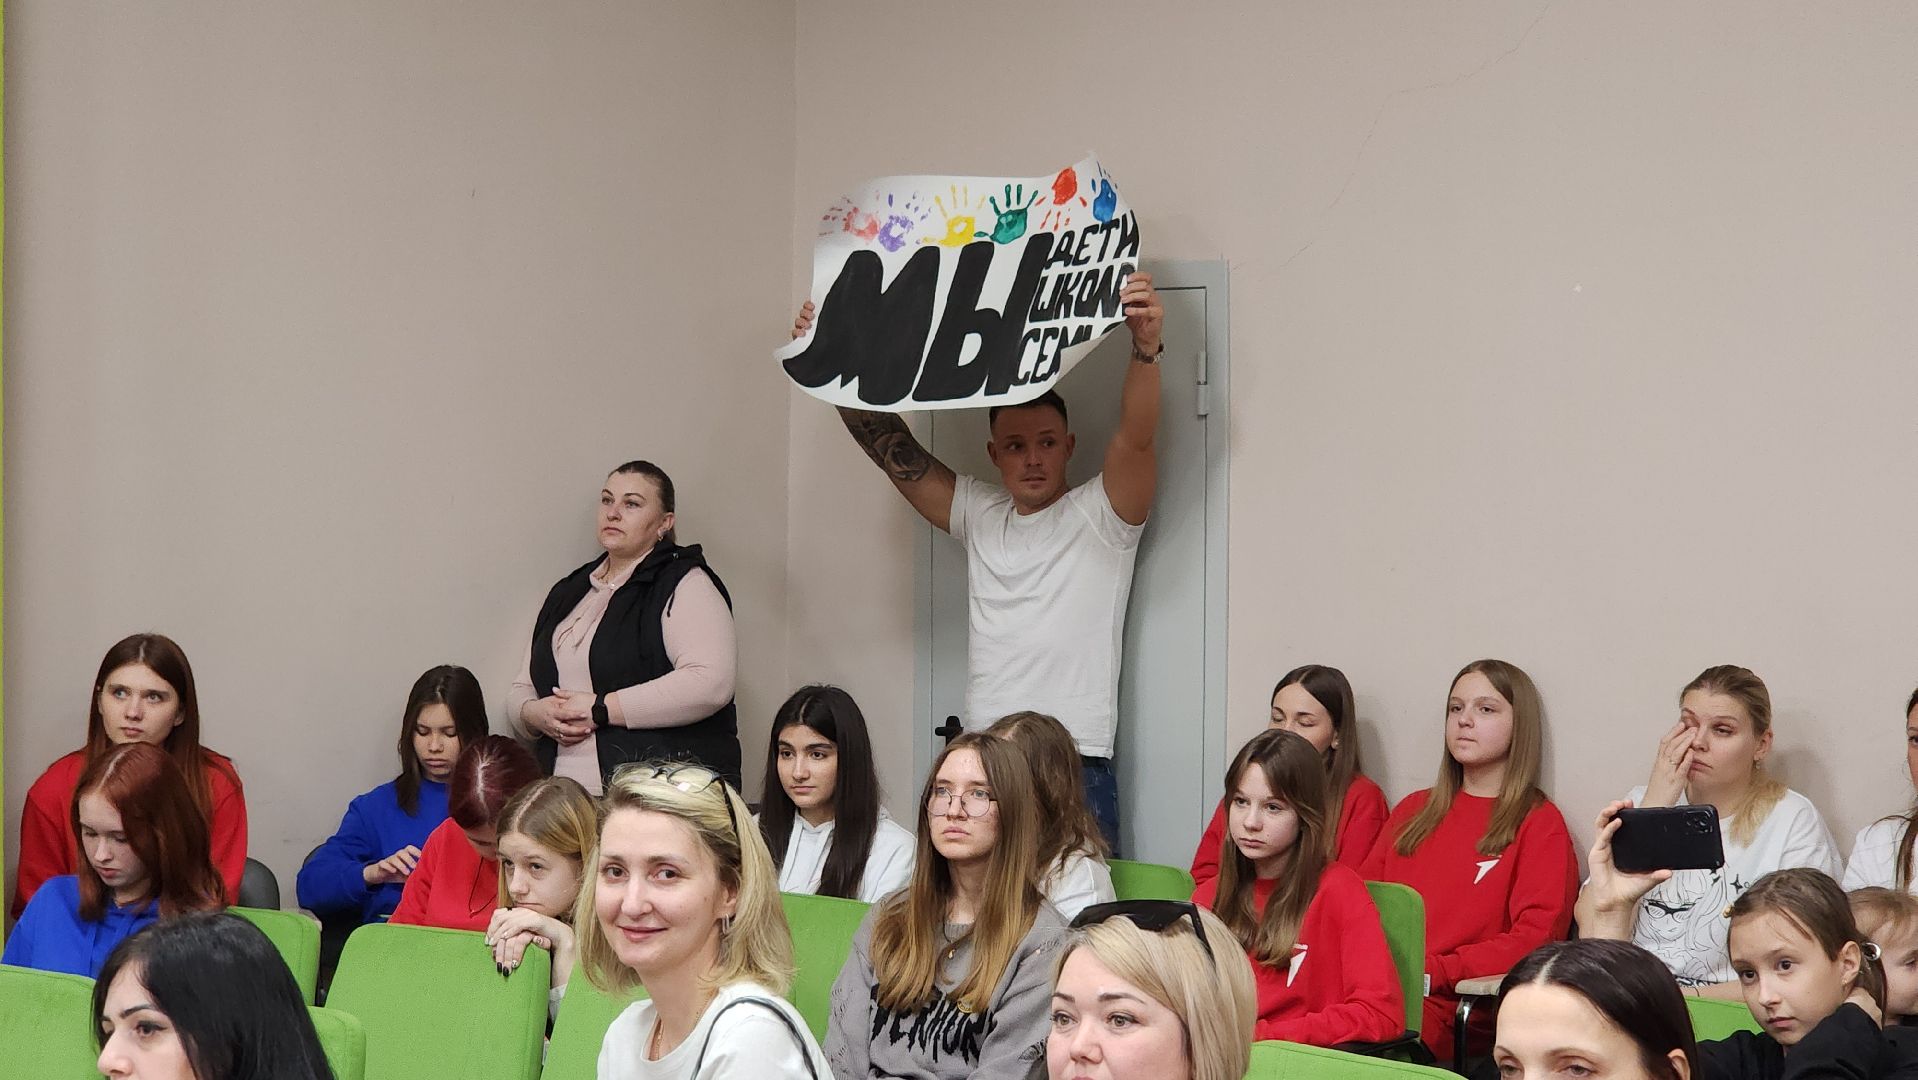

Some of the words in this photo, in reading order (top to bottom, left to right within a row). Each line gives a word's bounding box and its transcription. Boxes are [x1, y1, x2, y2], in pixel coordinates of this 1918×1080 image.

[1045, 210, 1140, 269] ДЕТИ
[782, 232, 1054, 405] МЫ
[1008, 321, 1121, 386] СЕМ
